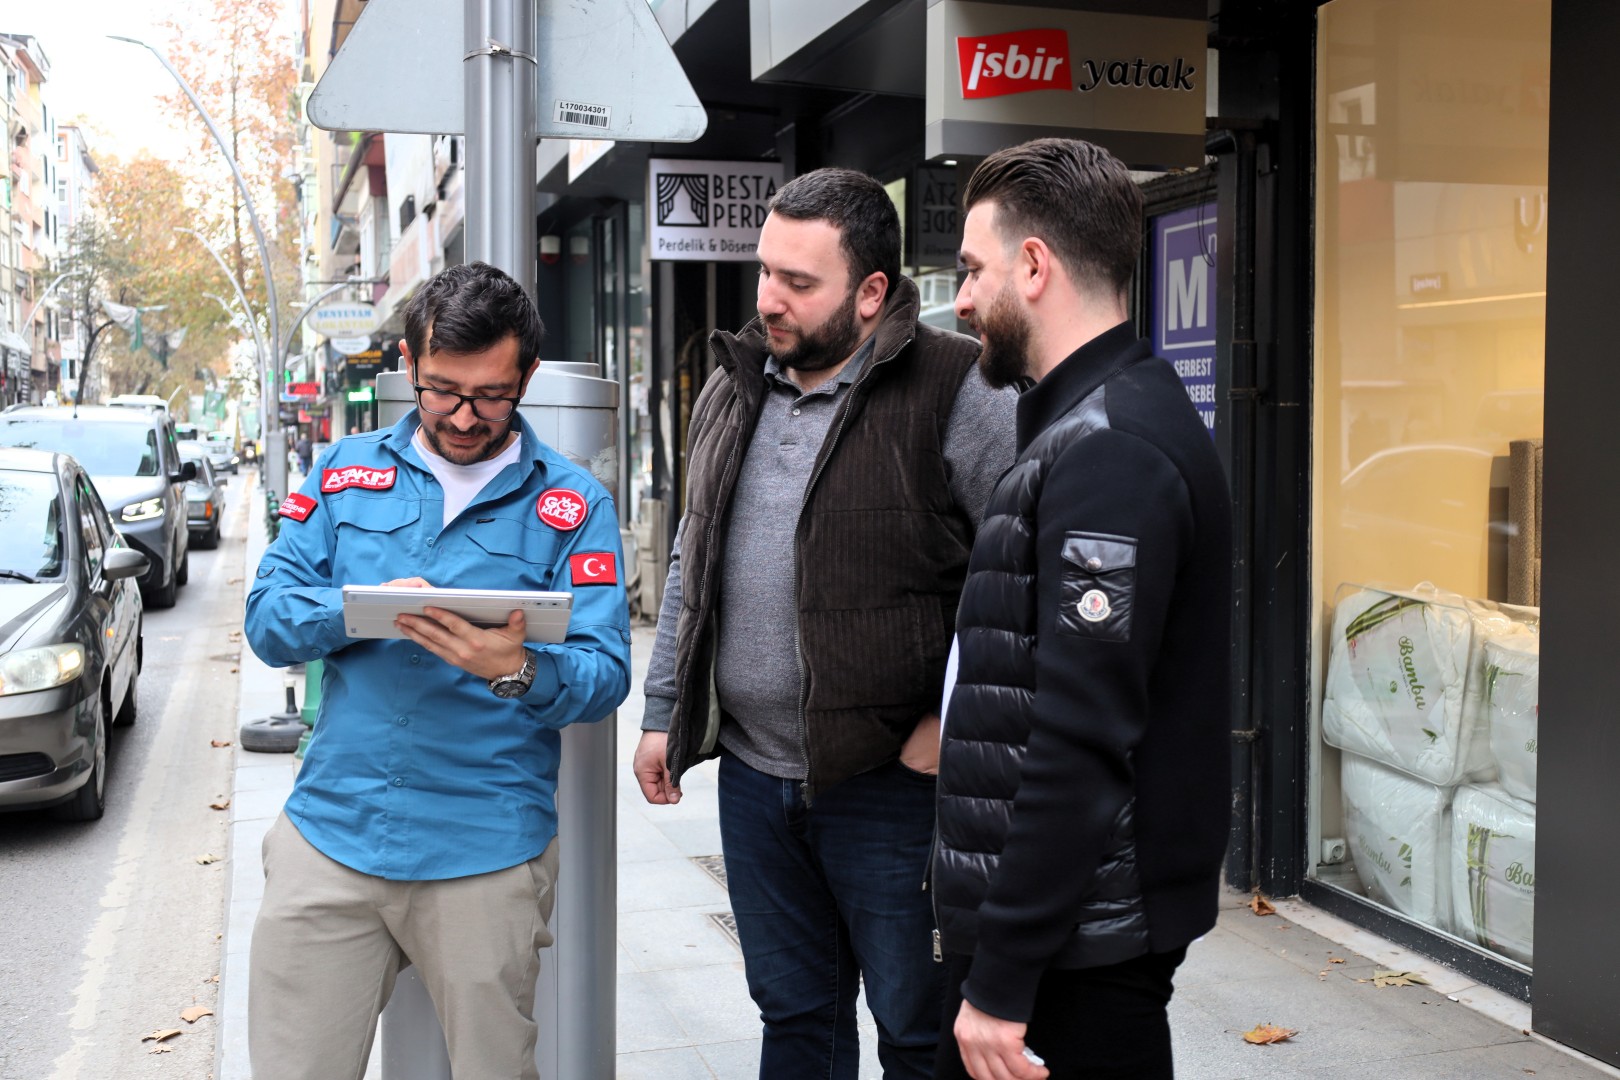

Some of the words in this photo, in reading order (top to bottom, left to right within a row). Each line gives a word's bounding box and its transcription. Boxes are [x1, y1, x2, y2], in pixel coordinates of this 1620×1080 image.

[1079, 57, 1196, 92] yatak
[560, 101, 606, 114] L170034301
[713, 174, 777, 200] BESTA
[659, 238, 705, 251] Perdelik
[709, 239, 717, 252] &
[1168, 254, 1208, 331] M
[1174, 357, 1212, 378] SERBEST
[1398, 635, 1426, 711] Bambu
